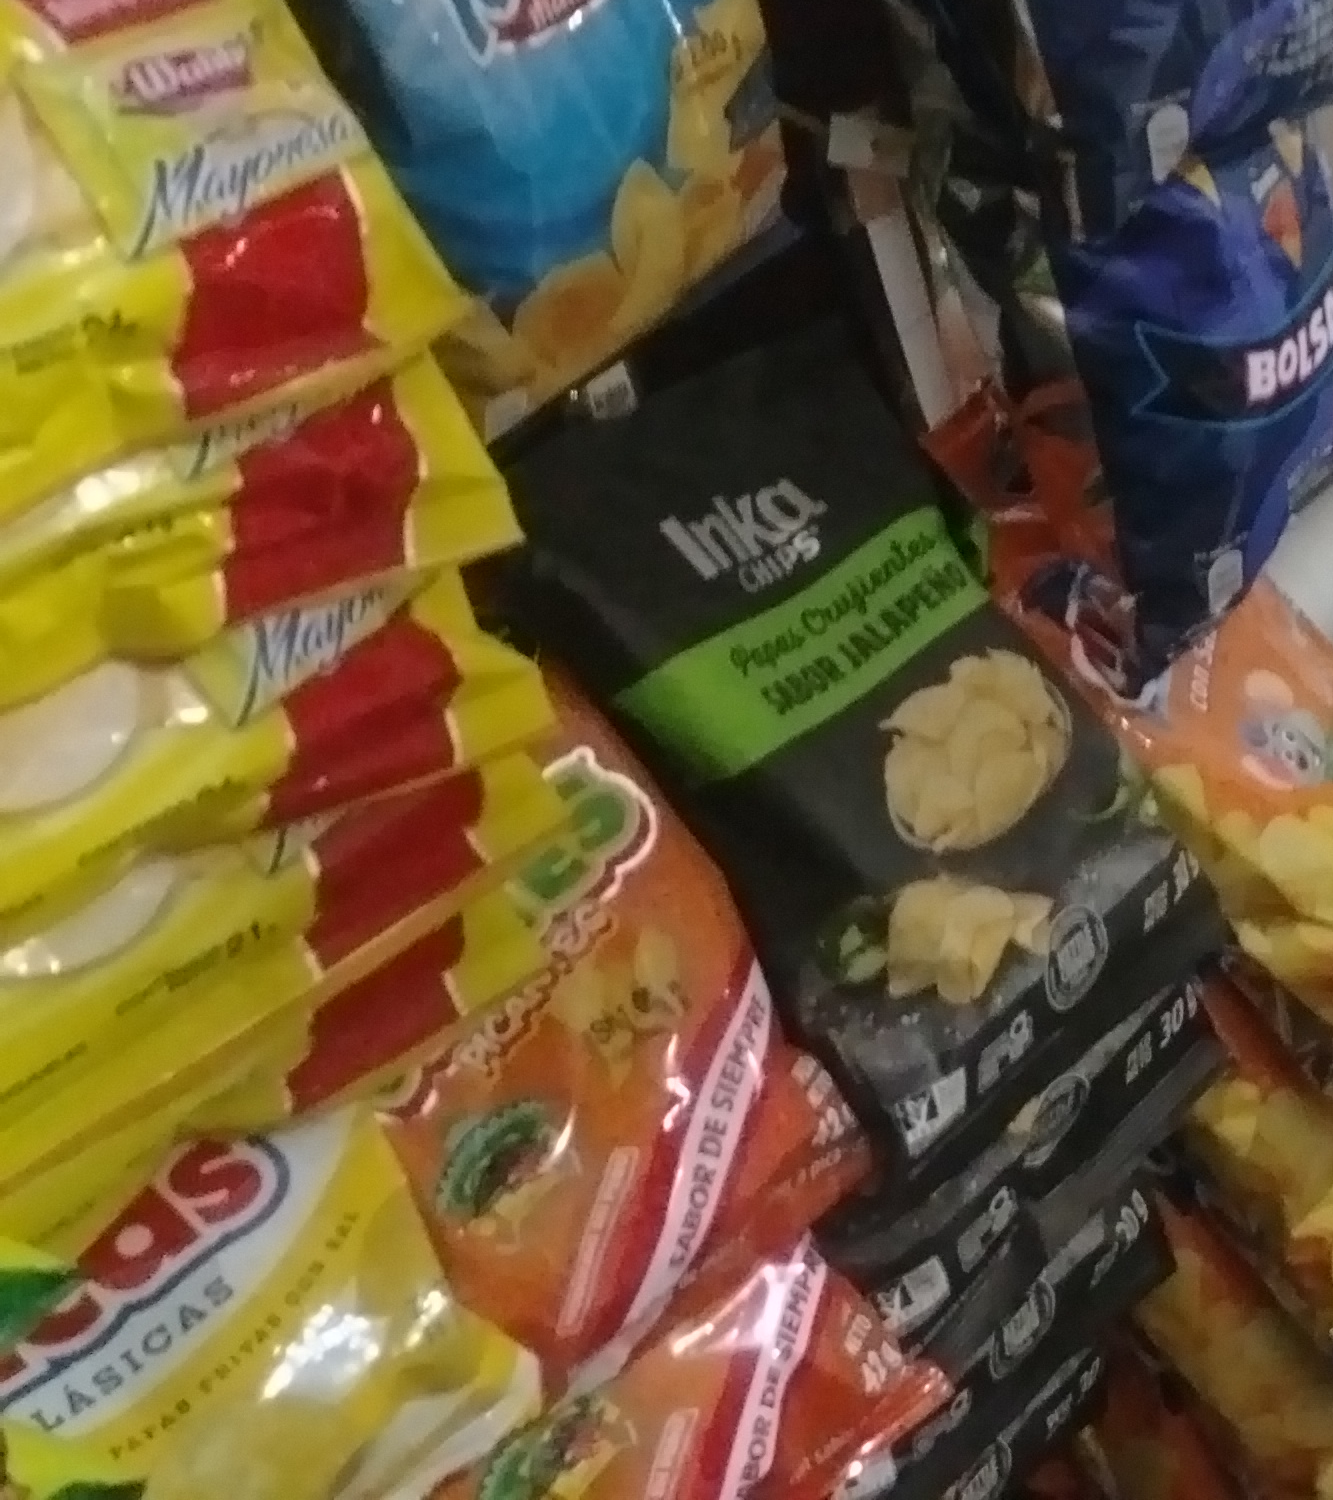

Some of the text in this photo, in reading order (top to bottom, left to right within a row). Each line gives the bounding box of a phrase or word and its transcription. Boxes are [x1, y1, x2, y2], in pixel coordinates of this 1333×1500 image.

[659, 476, 829, 582] Inka
[737, 523, 822, 594] CHIPS
[728, 626, 806, 679] Papas
[668, 1165, 718, 1271] SABOR
[699, 1116, 733, 1167] DE
[761, 1354, 784, 1403] DE
